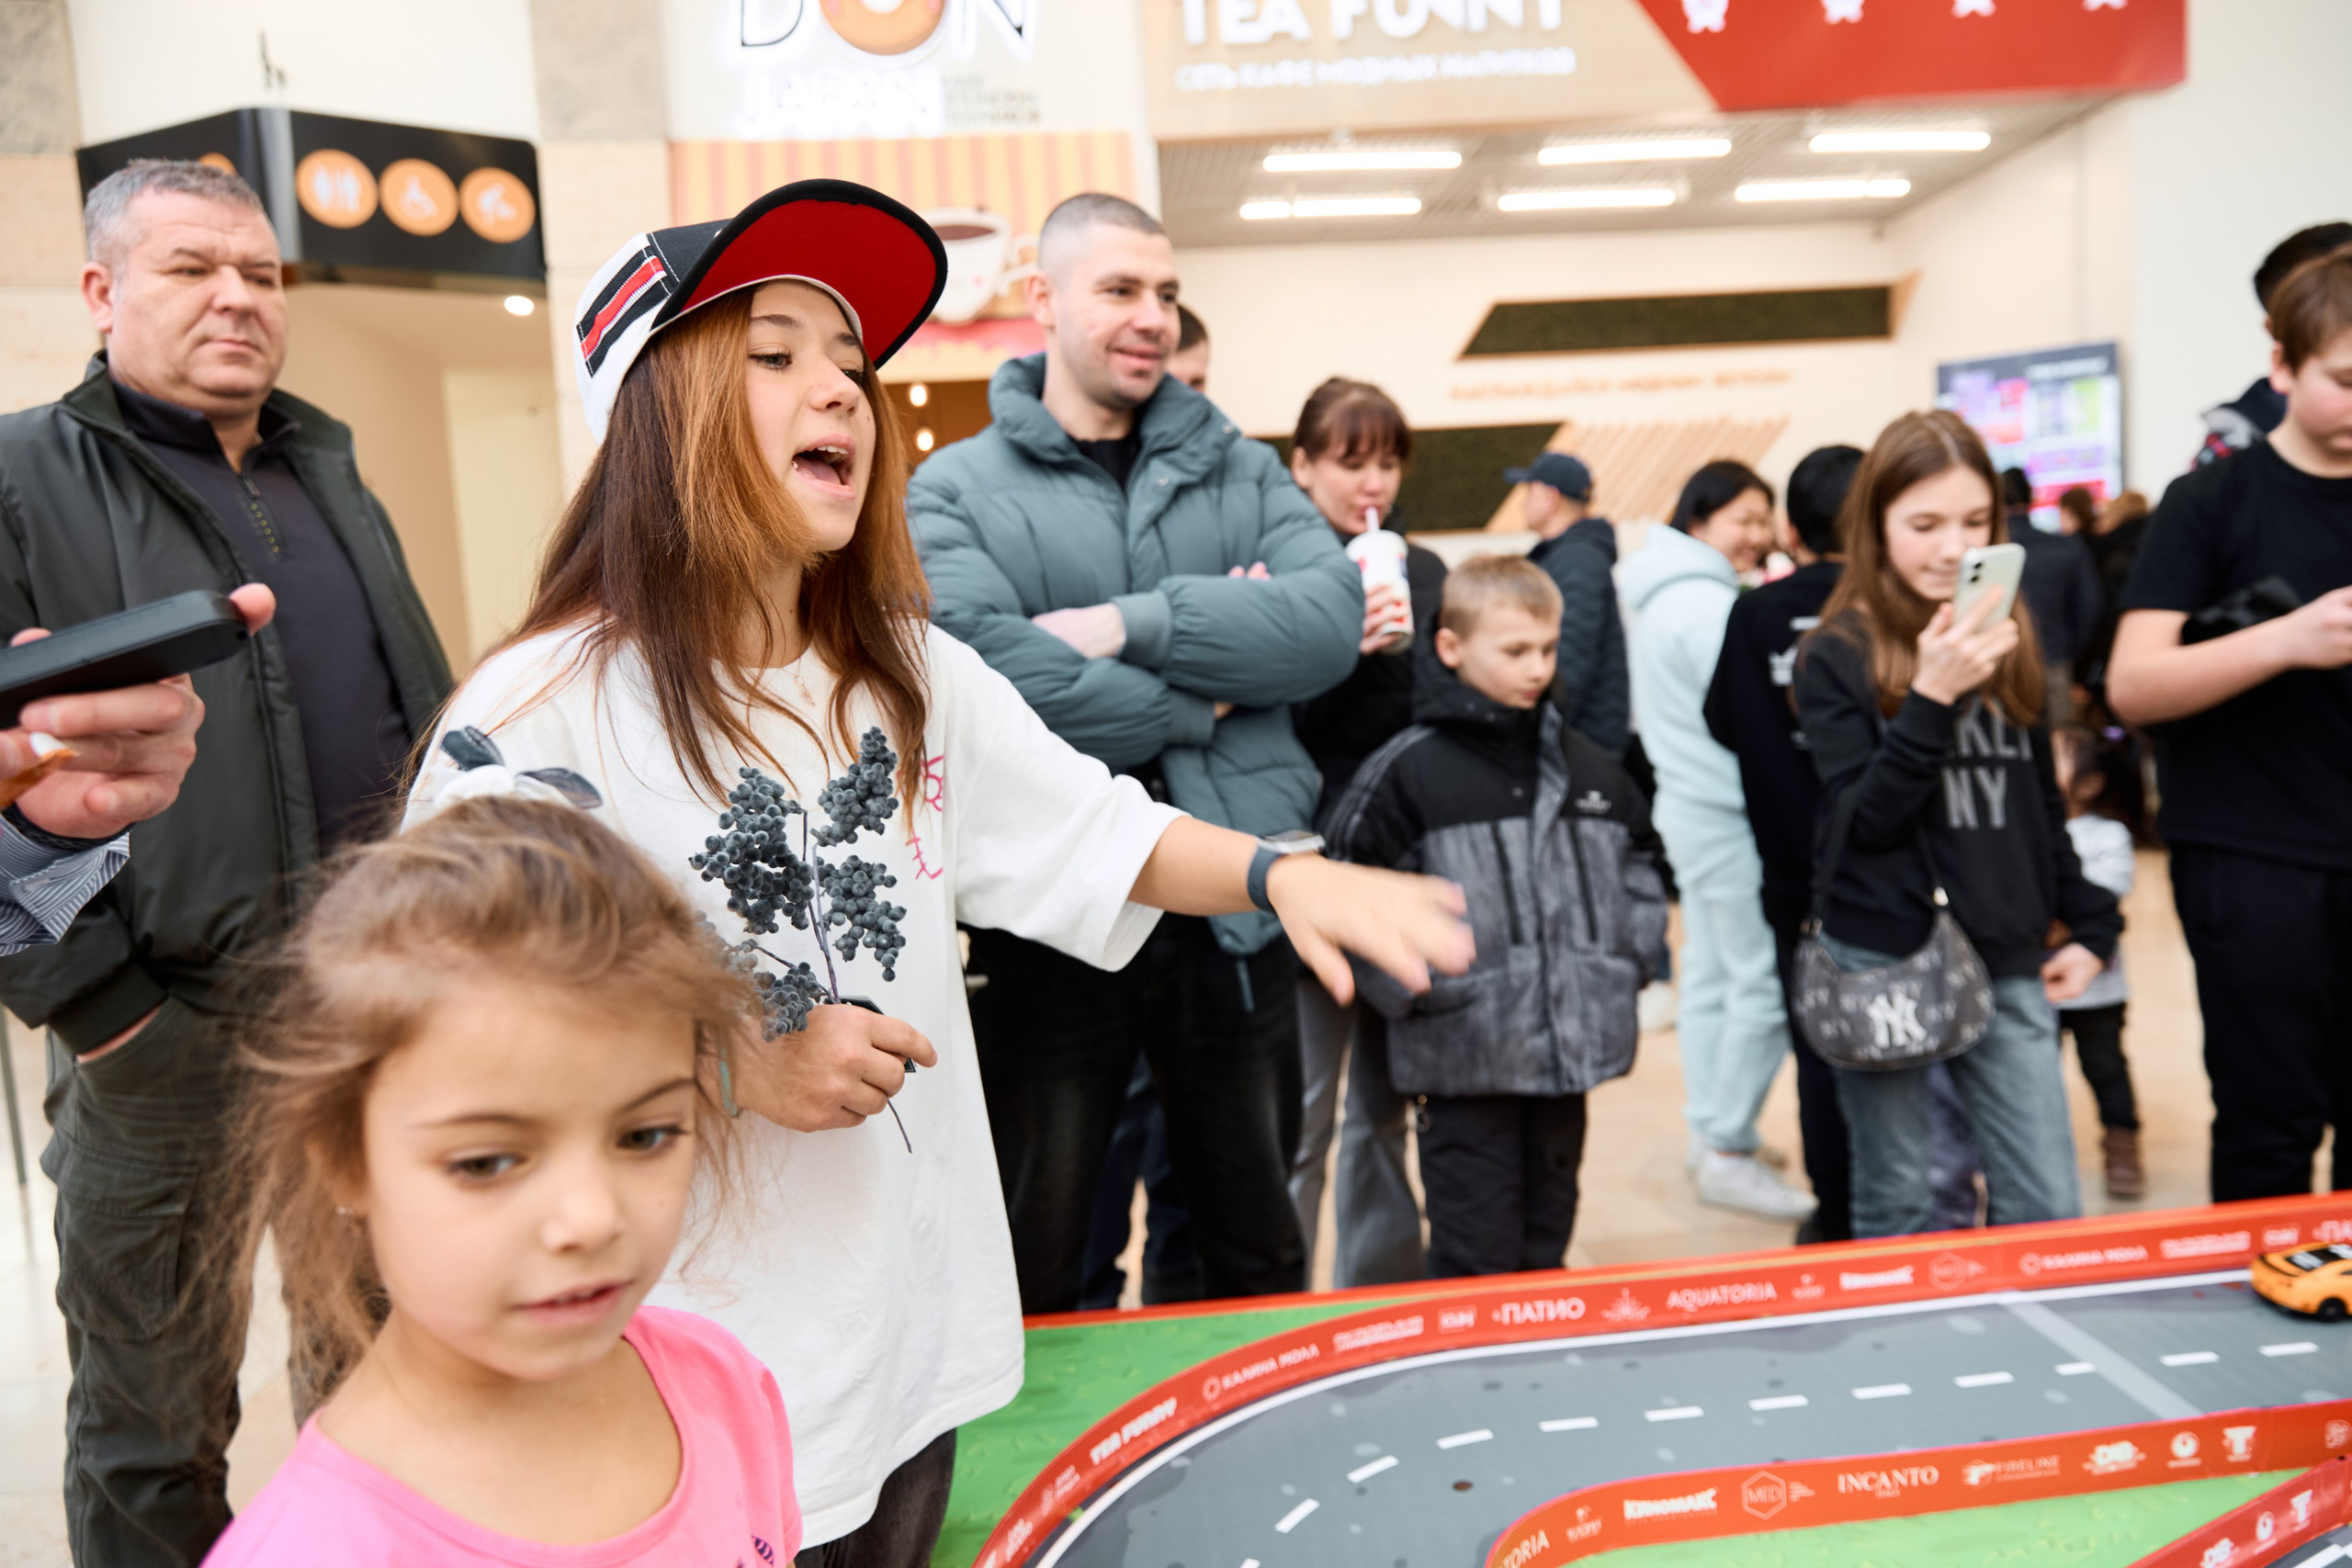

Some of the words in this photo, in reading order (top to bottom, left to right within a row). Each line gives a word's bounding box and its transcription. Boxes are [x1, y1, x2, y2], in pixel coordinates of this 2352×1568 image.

[1942, 765, 2007, 829] NY
[1665, 1281, 1778, 1312] AQUATORIA
[1221, 1357, 1278, 1391] КАЛИНА
[1090, 1431, 1122, 1466] TEA
[1838, 1465, 1939, 1495] INCANTO
